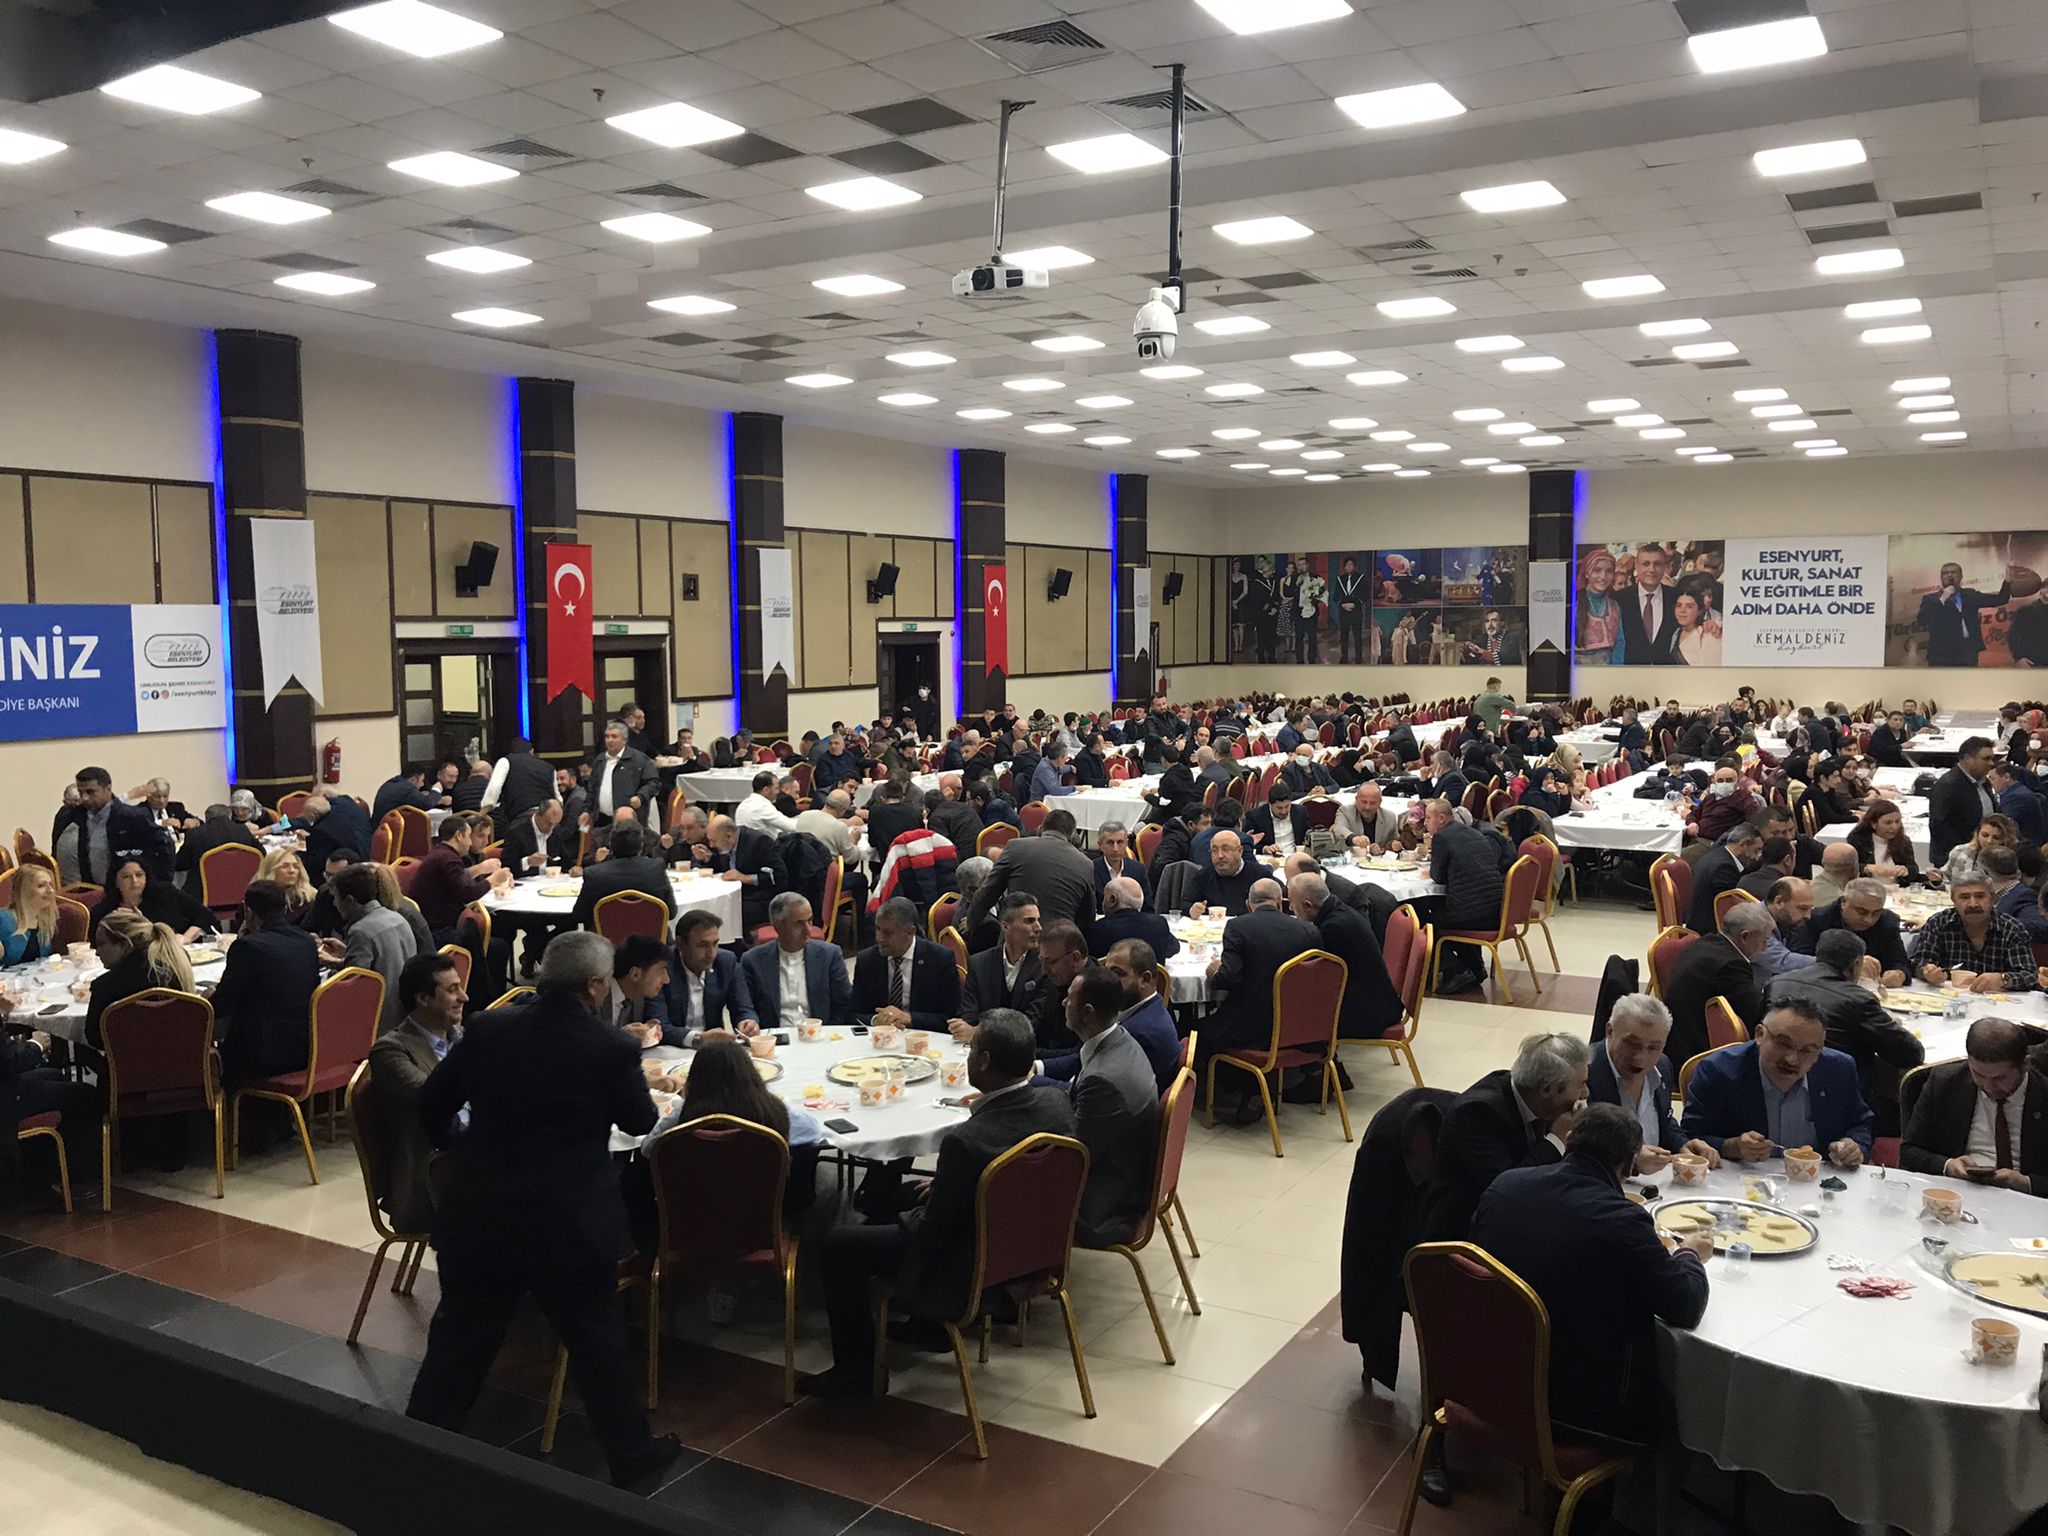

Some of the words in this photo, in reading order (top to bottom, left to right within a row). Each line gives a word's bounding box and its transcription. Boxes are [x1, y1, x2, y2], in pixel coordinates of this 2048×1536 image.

[1759, 550, 1844, 564] ESENYURT,
[1808, 566, 1862, 580] SANAT
[1740, 586, 1760, 598] VE
[1764, 584, 1835, 598] EĞİTİMLE
[1838, 585, 1863, 597] BİR
[1731, 603, 1772, 616] ADIM
[1775, 602, 1823, 615] DAHA
[1827, 601, 1875, 615] ÖNDE
[1756, 633, 1801, 645] KEMAL
[28, 696, 80, 713] BAŞKANI
